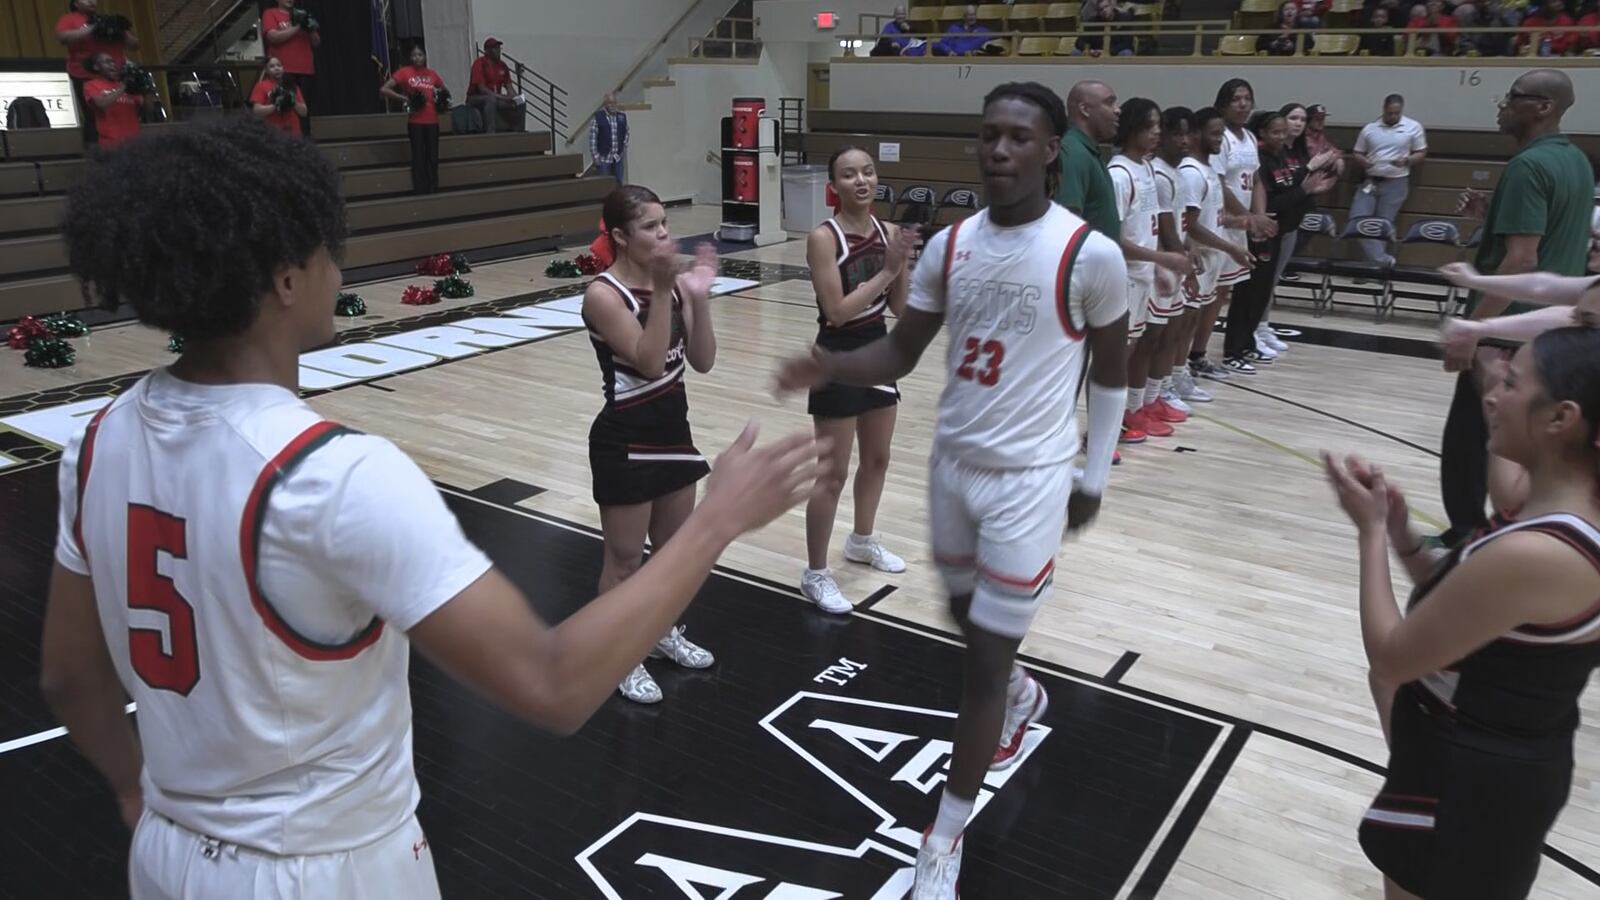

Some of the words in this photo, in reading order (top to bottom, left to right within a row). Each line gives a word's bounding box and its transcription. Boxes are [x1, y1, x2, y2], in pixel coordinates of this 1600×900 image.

[958, 65, 972, 80] 17
[1459, 70, 1481, 87] 16
[956, 336, 1006, 387] 23
[127, 502, 201, 697] 5
[813, 657, 868, 687] TM
